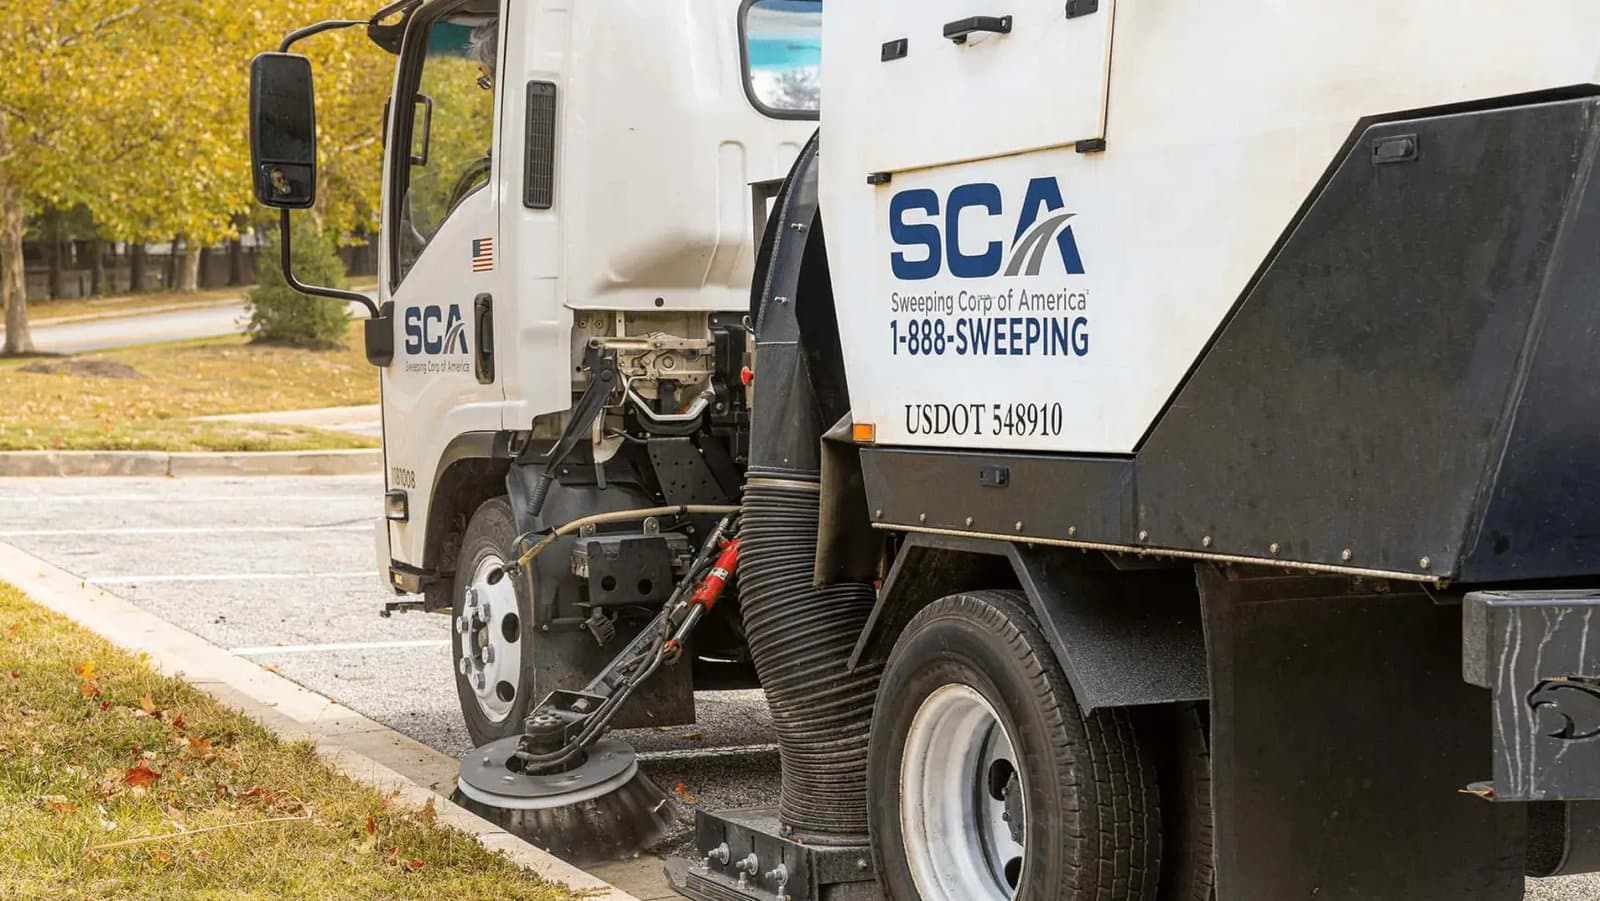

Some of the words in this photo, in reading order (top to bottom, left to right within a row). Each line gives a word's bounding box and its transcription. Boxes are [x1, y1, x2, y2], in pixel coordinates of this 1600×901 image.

[889, 176, 1085, 281] SCA
[891, 291, 953, 317] Sweeping
[958, 291, 993, 316] Corp
[997, 288, 1014, 312] of
[405, 303, 468, 355] SCA
[890, 316, 1089, 357] 1-888-SWEEPING
[905, 403, 986, 436] USDOT
[992, 402, 1063, 436] 548910
